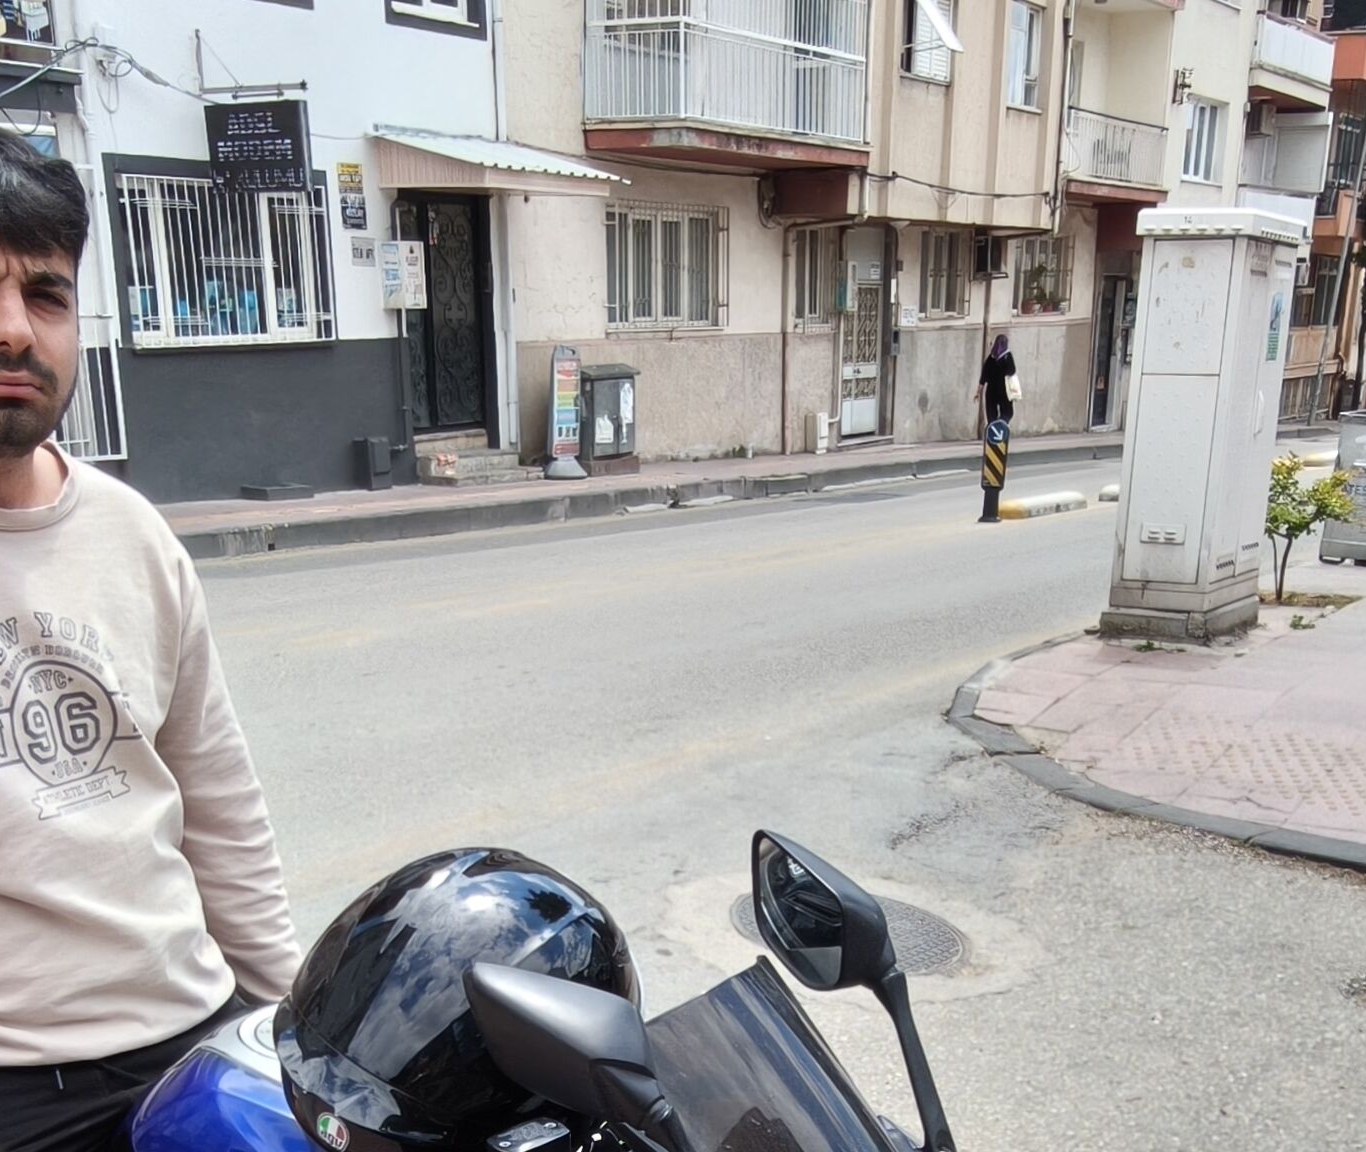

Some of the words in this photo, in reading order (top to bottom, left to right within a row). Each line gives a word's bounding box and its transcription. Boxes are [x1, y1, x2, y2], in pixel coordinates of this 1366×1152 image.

[33, 611, 115, 662] YOR
[29, 669, 67, 694] NYC
[22, 691, 101, 765] 96
